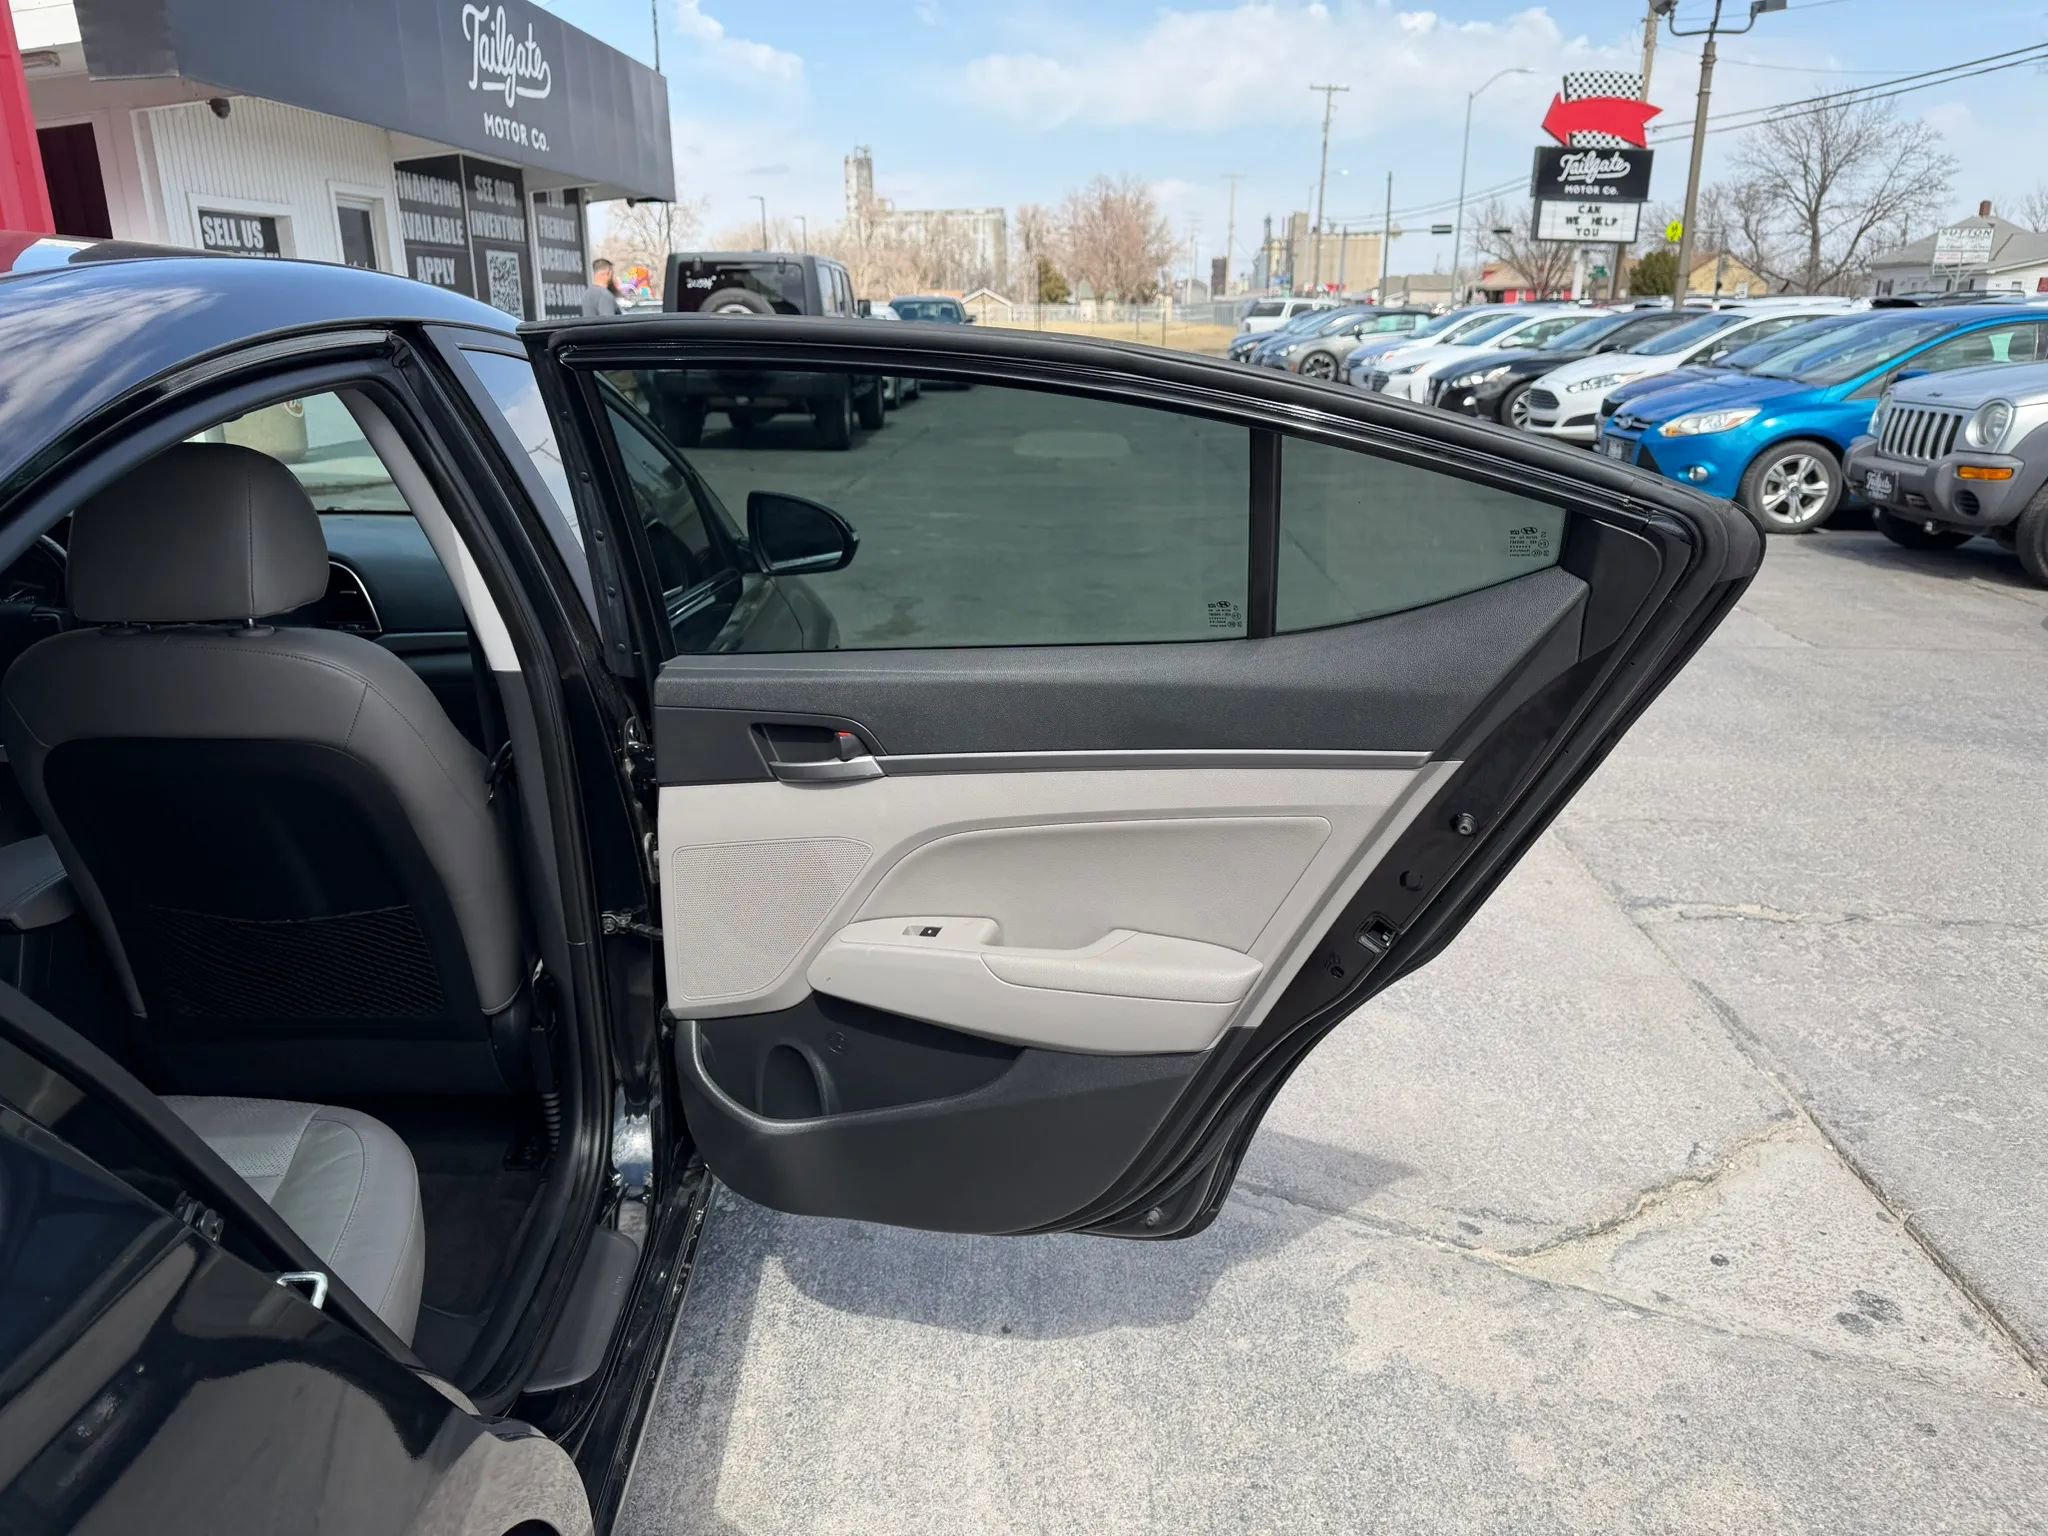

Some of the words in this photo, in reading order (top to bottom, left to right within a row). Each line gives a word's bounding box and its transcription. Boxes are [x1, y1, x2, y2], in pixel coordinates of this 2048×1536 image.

[462, 3, 551, 108] Tailgate
[484, 111, 529, 146] MOTOR
[531, 128, 550, 152] CO.
[1556, 150, 1631, 184] Tailgate
[395, 169, 461, 208] INANCING
[474, 174, 495, 203] SEE
[494, 180, 516, 207] OUR
[1564, 184, 1600, 195] MOTOR
[1565, 216, 1580, 225] WE
[1591, 217, 1618, 226] HELP
[1578, 205, 1601, 214] CAN
[202, 215, 241, 247] SELL
[240, 218, 264, 249] US
[470, 210, 525, 242] INVENTORY
[1576, 228, 1600, 236] YOU
[416, 255, 455, 285] APPLY
